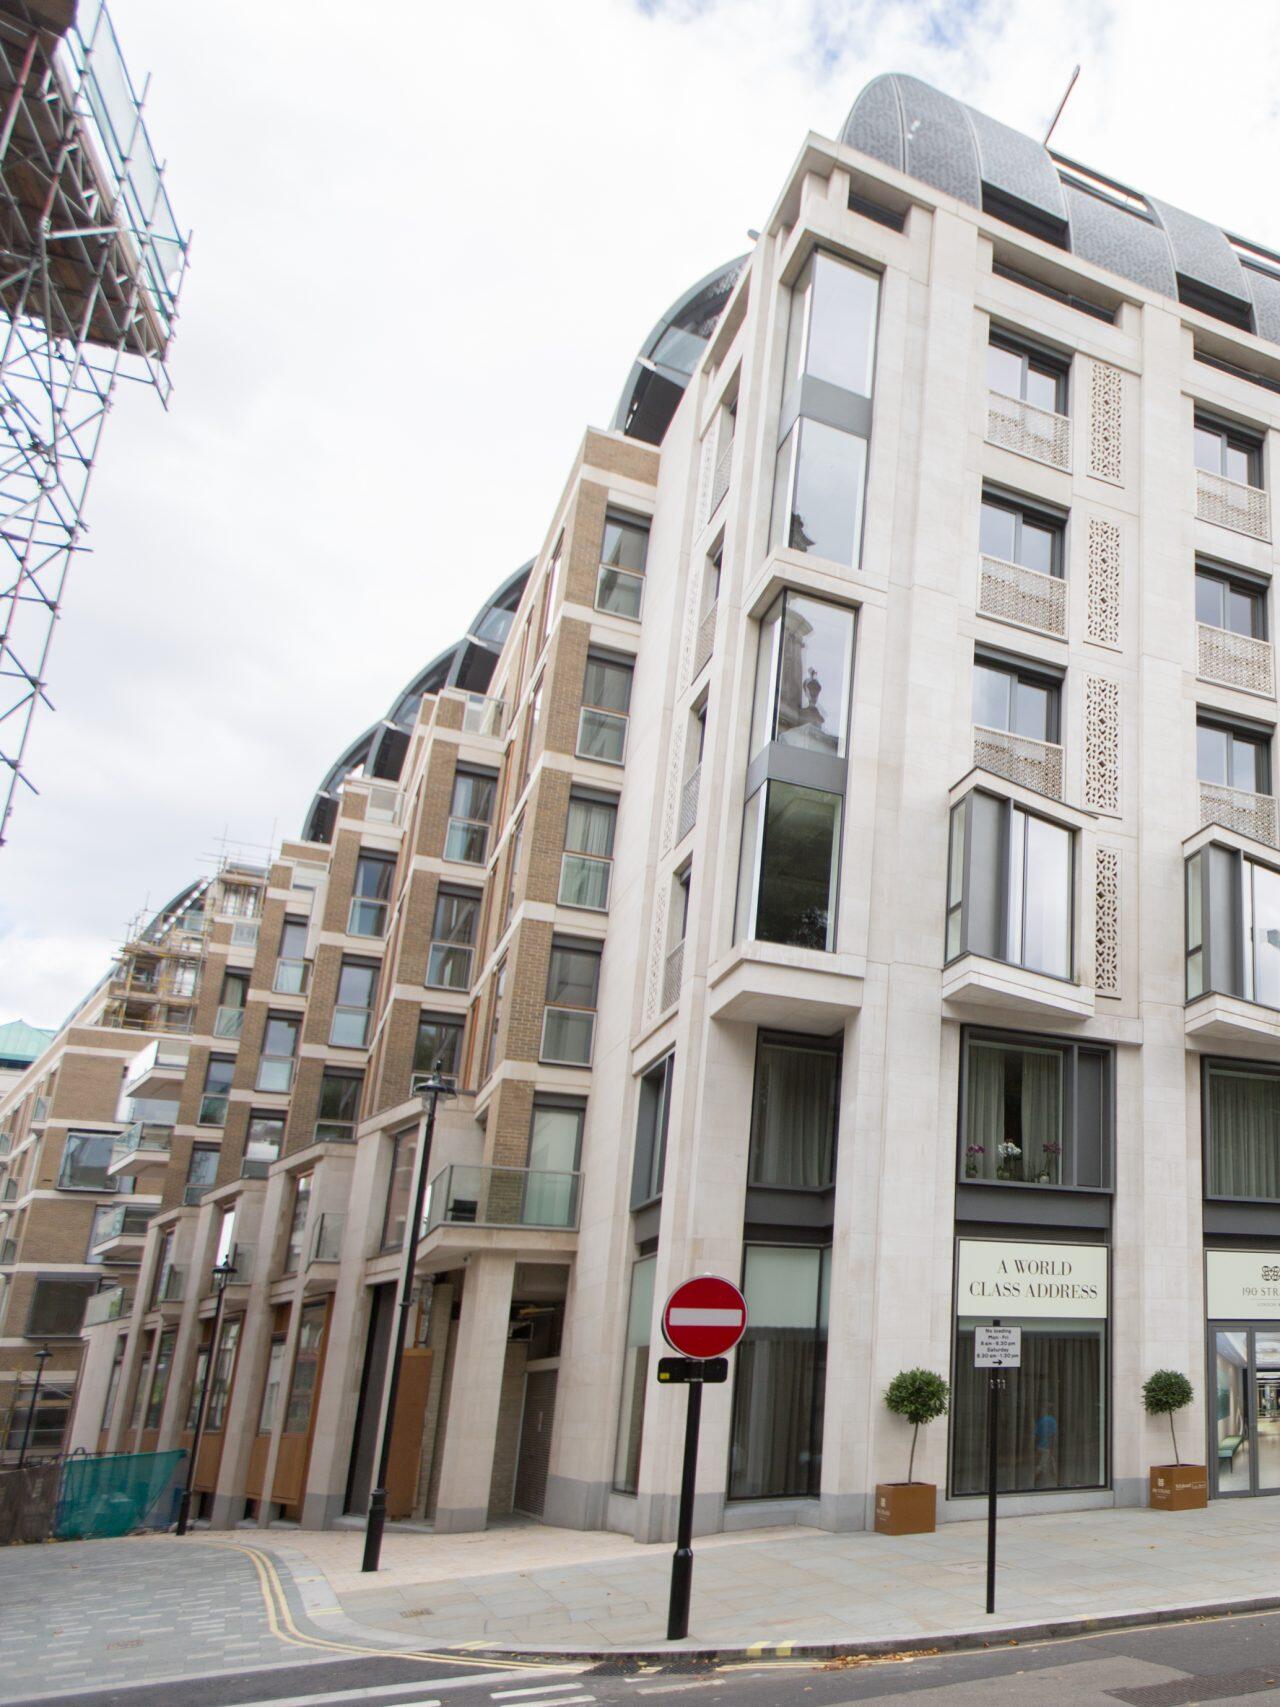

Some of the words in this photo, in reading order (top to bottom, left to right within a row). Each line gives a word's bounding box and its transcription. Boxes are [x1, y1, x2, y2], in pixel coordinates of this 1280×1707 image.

[998, 1259, 1008, 1274] A
[1014, 1259, 1072, 1276] WORLD
[969, 1281, 1021, 1298] CLASS
[1026, 1283, 1098, 1300] ADDRESS
[1241, 1286, 1258, 1297] 190
